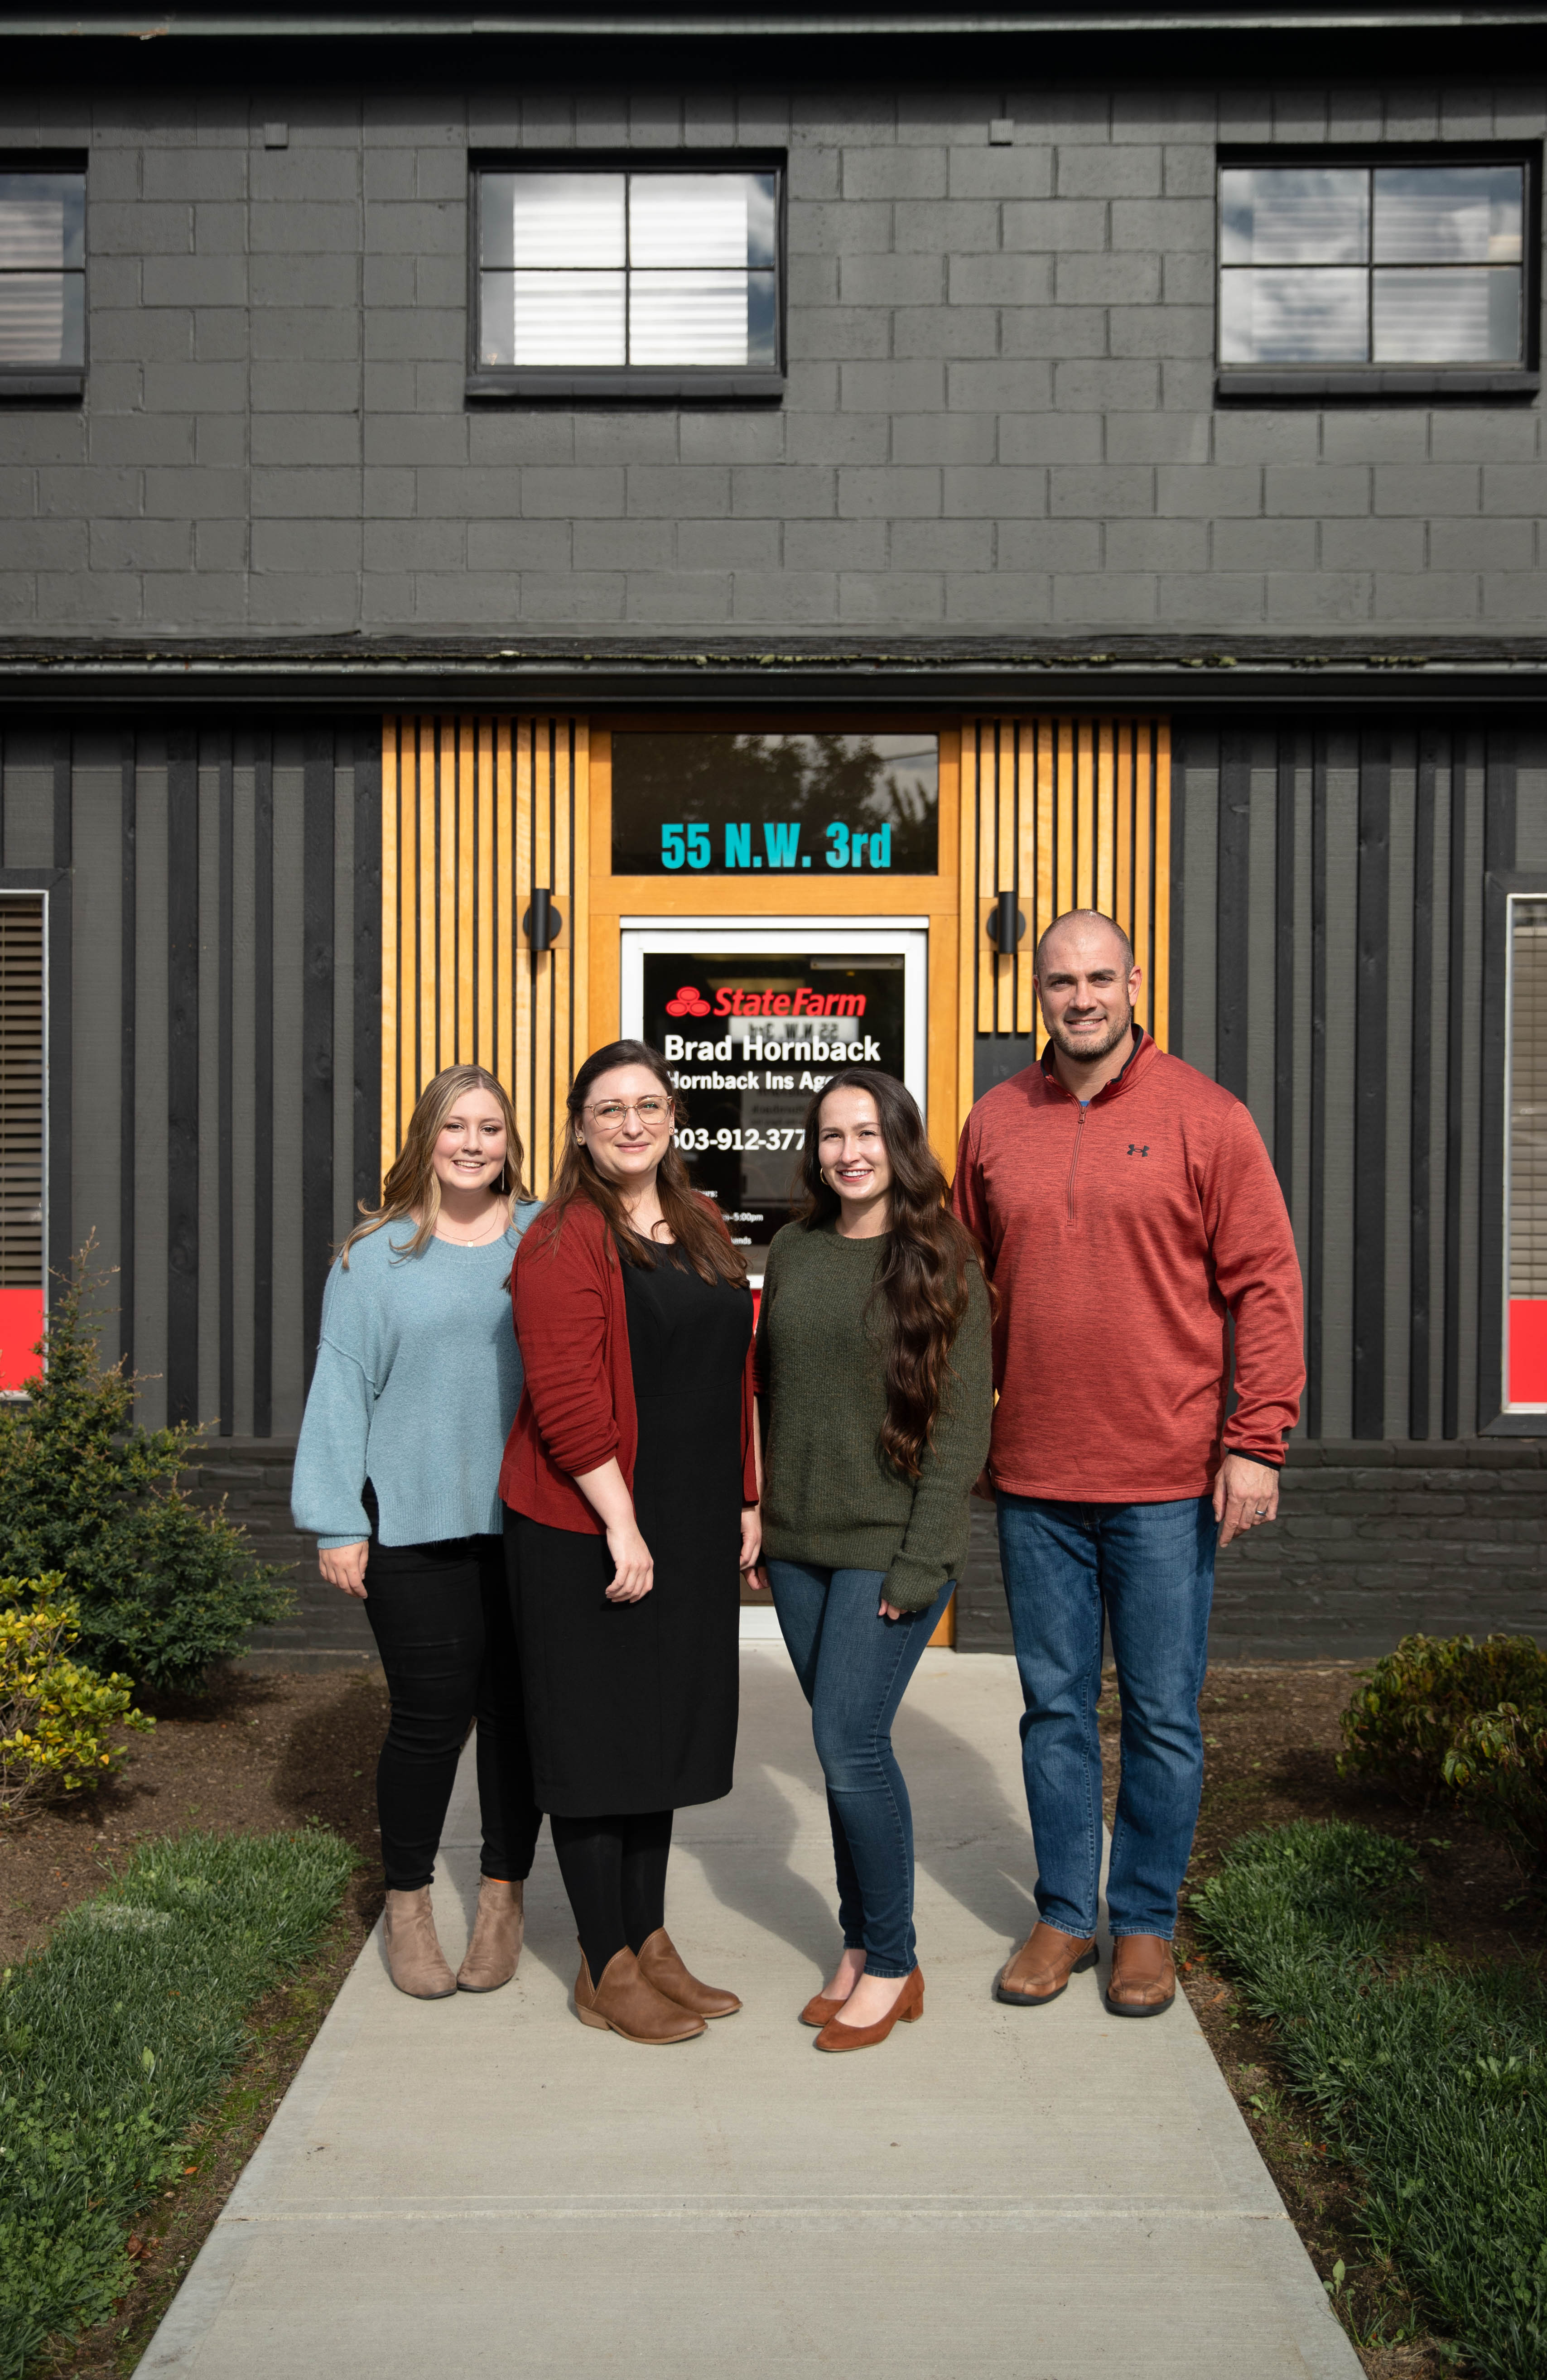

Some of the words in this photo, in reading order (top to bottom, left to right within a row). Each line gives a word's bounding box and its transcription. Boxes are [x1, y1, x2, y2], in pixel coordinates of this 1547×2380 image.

[661, 823, 711, 869] 55
[725, 822, 811, 868] N.W.
[826, 822, 892, 868] 3rd
[665, 1035, 732, 1061] Brad
[742, 1035, 881, 1061] Hornback
[667, 1070, 760, 1090] Hornback
[766, 1071, 794, 1090] Ins
